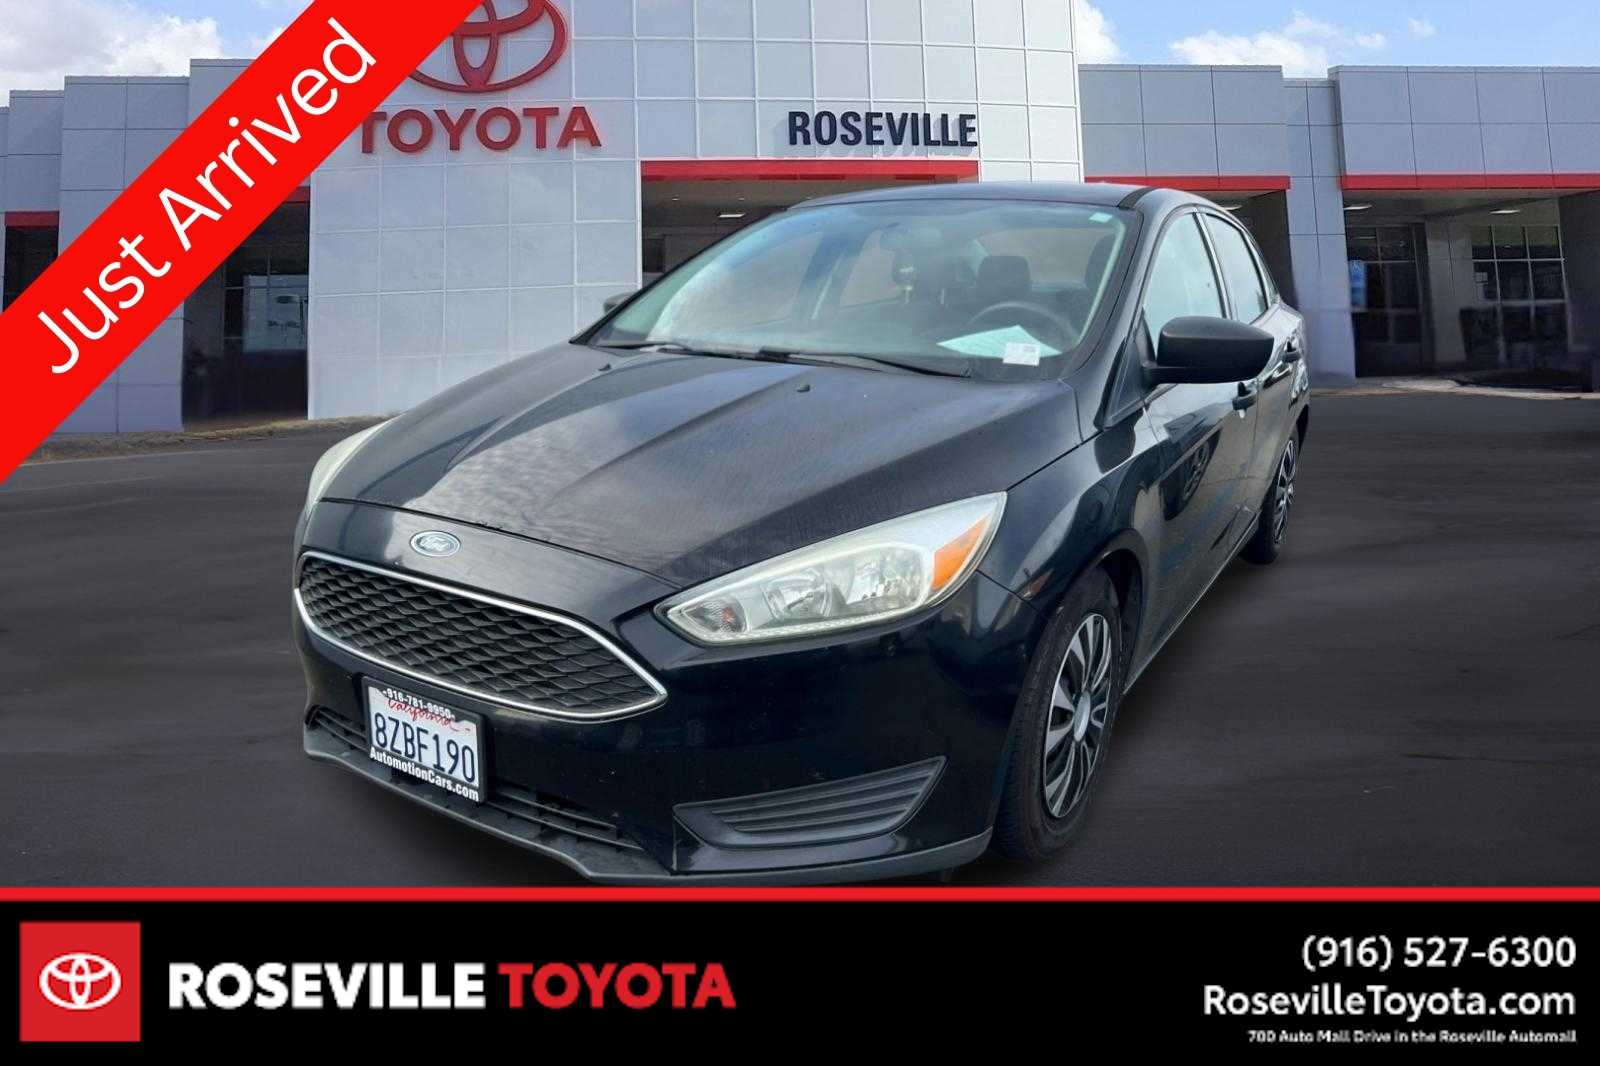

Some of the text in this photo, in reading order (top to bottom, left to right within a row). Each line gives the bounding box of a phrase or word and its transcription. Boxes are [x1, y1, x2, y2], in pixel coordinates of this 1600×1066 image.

[361, 106, 602, 154] TOYOTA
[788, 111, 978, 147] ROSEVILLE
[374, 712, 476, 783] 8ZBF190
[370, 747, 479, 802] AutomotionCars.com
